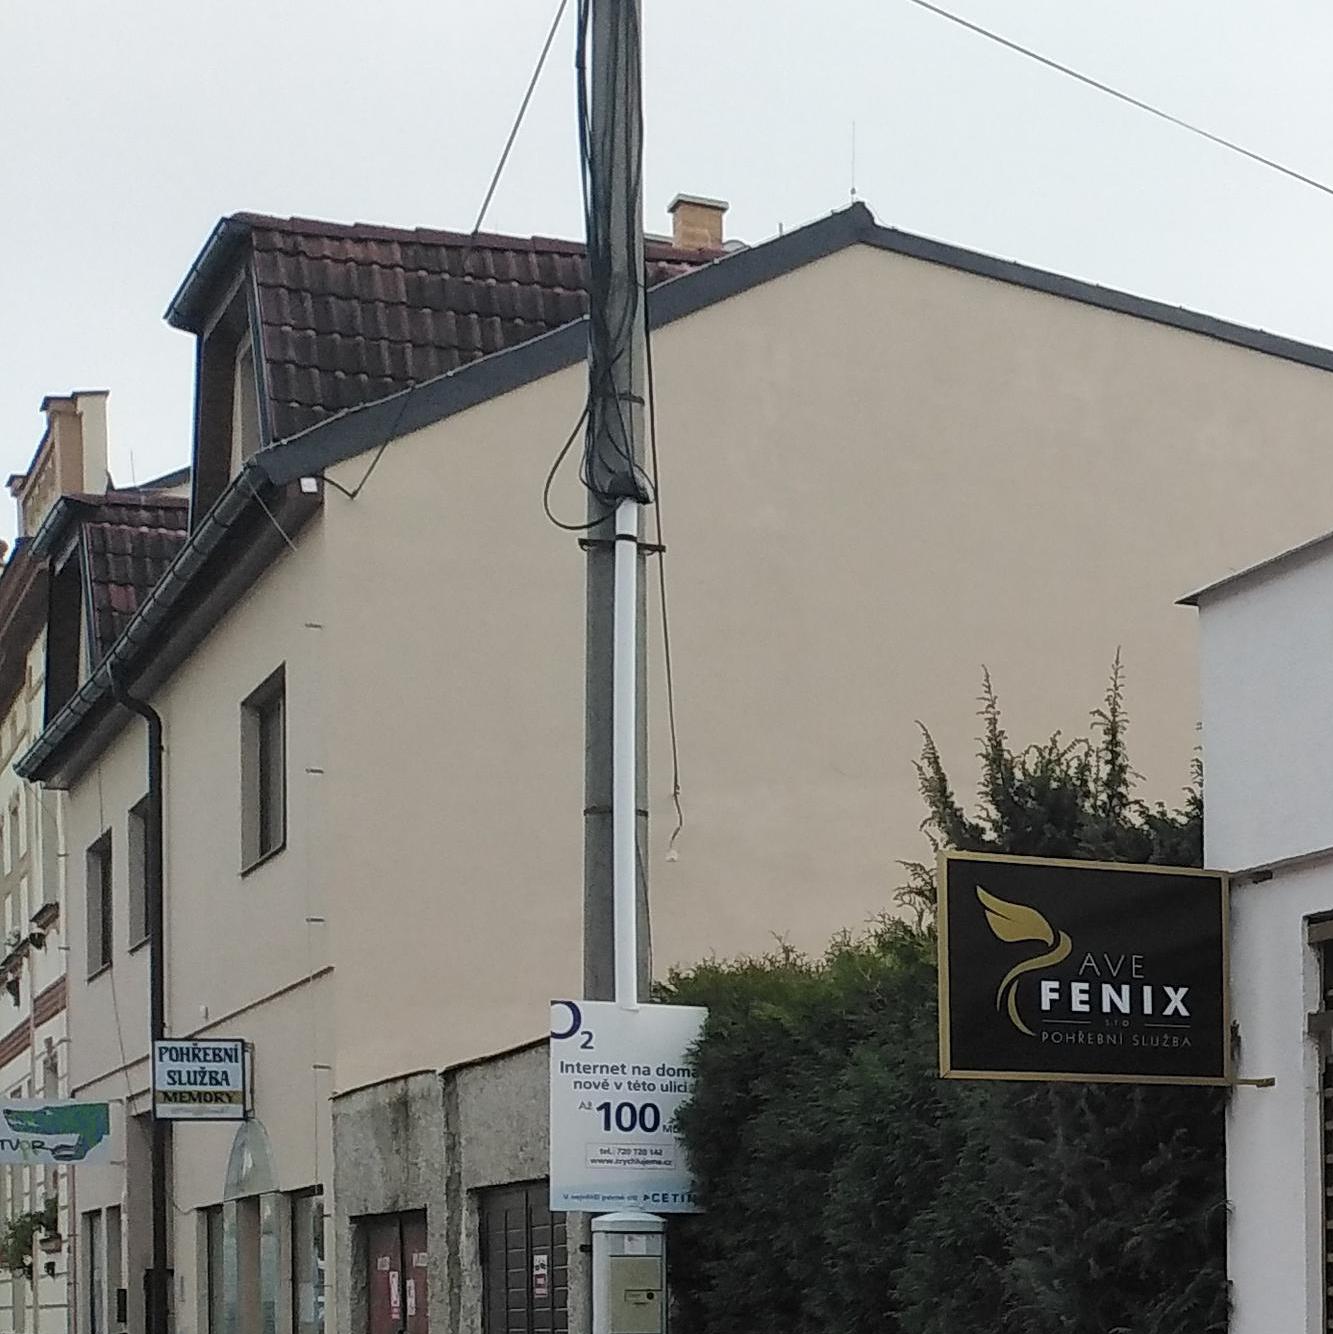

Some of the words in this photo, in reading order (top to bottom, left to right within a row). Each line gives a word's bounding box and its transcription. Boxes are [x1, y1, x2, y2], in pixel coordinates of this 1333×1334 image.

[1078, 952, 1145, 978] AVE
[1040, 980, 1191, 1017] FENIX
[1041, 1030, 1123, 1046] POHŘEBNÍ
[1132, 1033, 1192, 1048] SLUŽBA
[158, 1042, 239, 1063] POHŘEBNÍ
[166, 1066, 231, 1086] SLUŽBA
[560, 1060, 627, 1076] Internet
[632, 1066, 651, 1077] na
[573, 1078, 609, 1091] nově
[614, 1081, 623, 1090] v
[627, 1079, 656, 1092] této
[661, 1080, 688, 1093] ulici
[162, 1090, 236, 1103] MEMORY
[596, 1101, 661, 1133] 100
